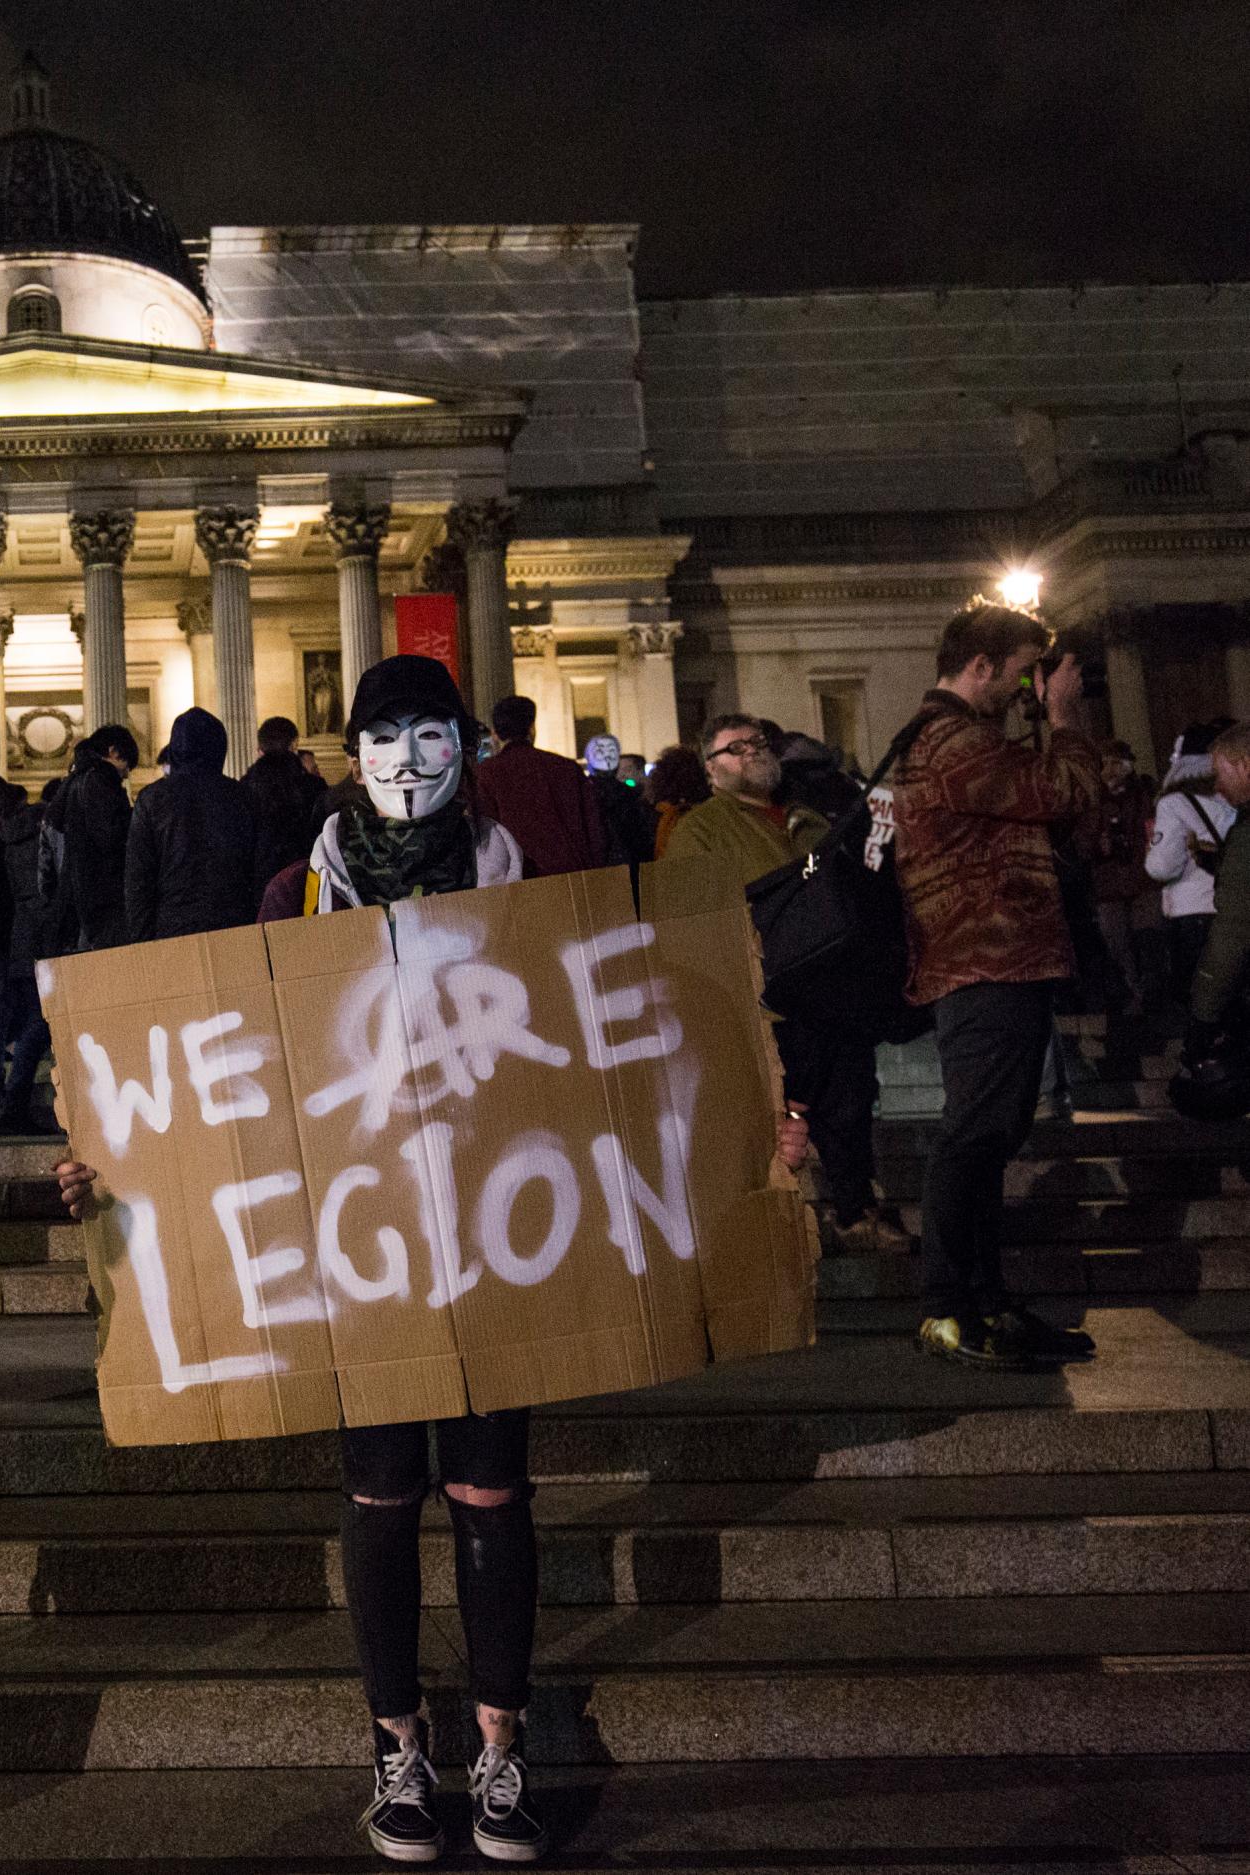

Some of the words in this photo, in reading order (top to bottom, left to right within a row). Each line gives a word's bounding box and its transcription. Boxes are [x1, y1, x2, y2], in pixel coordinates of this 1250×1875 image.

[76, 1010, 271, 1160] WE
[303, 910, 690, 1135] ARE
[118, 1105, 696, 1394] LEGION
